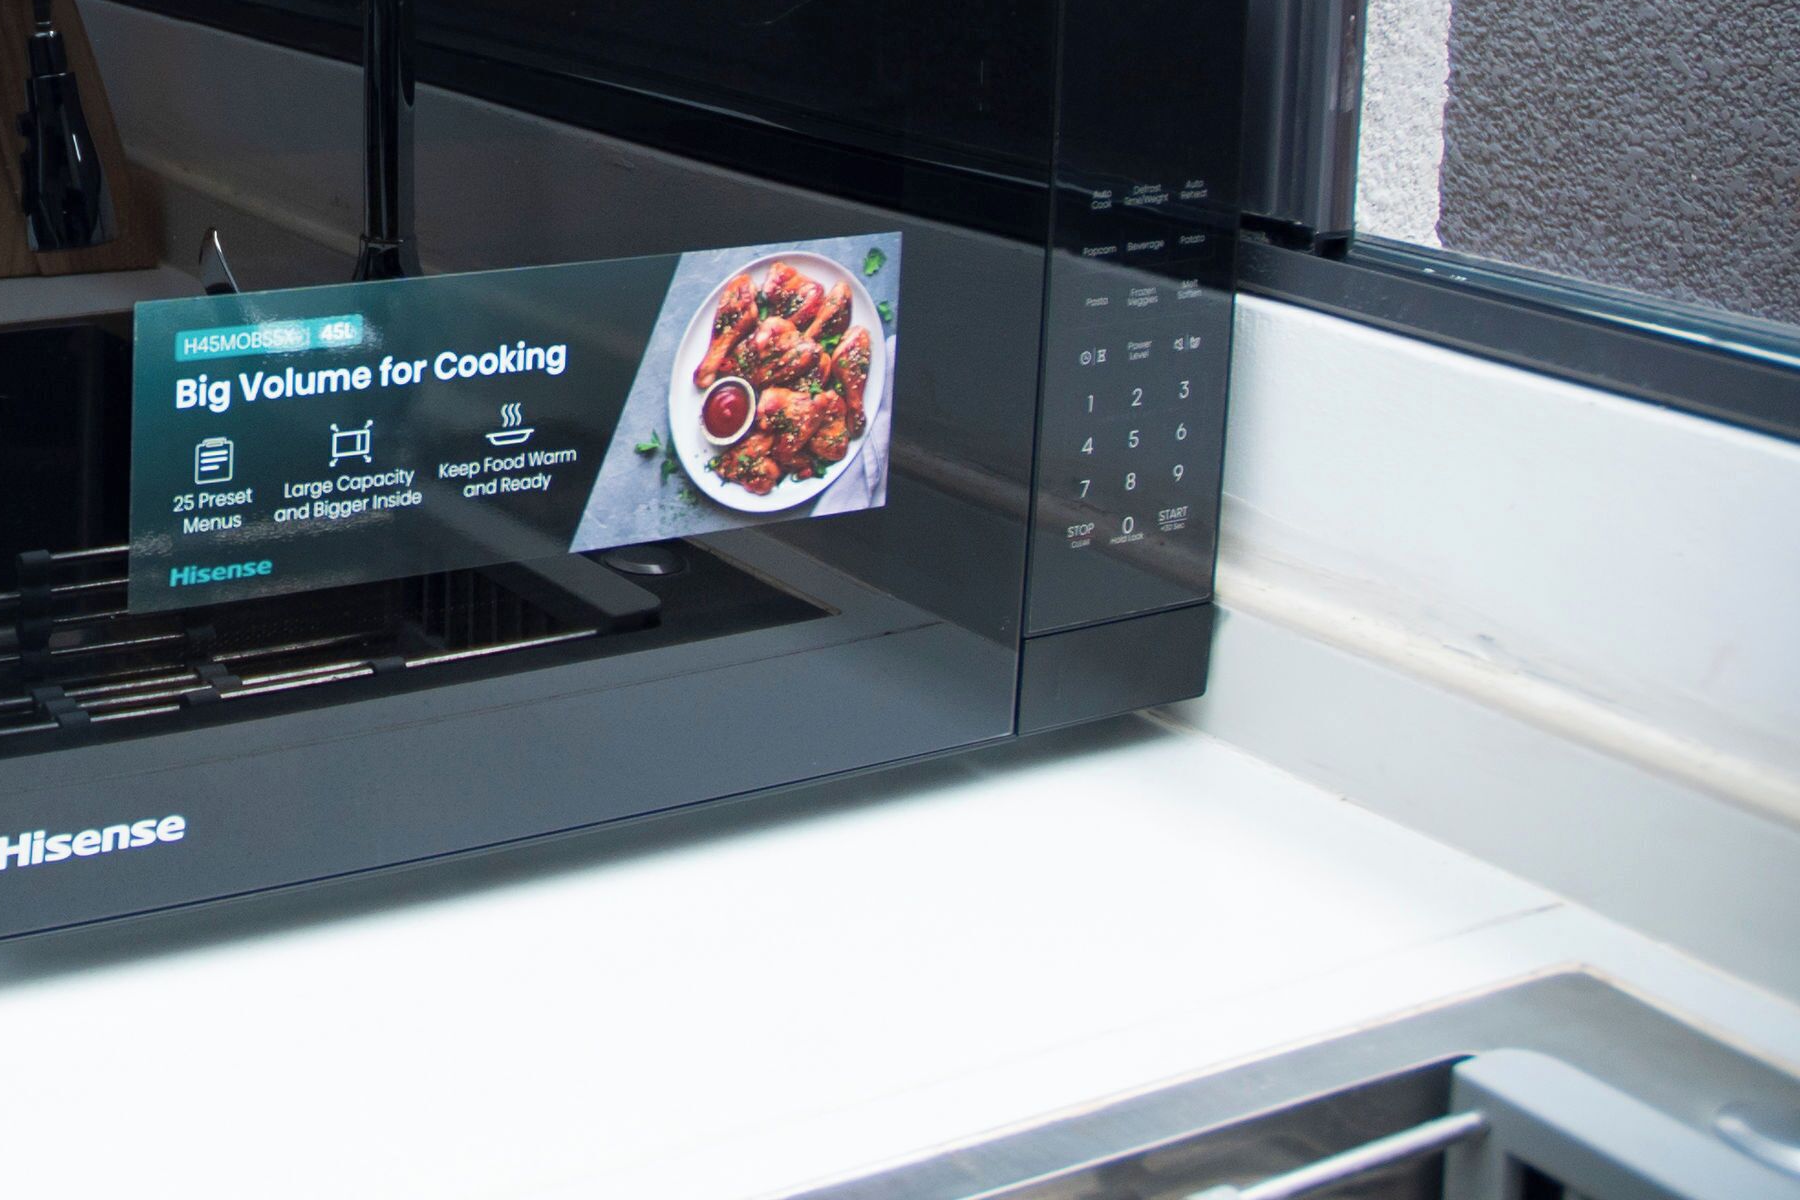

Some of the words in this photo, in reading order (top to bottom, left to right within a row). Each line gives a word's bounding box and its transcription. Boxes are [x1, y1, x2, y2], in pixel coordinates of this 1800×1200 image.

[1092, 200, 1112, 210] Cook
[1127, 240, 1165, 252] Beverage
[1180, 234, 1206, 245] Potato
[1083, 245, 1117, 257] Popcorn
[176, 374, 231, 413] Big
[238, 367, 372, 402] Volume
[379, 356, 427, 387] for
[434, 340, 567, 380] Cooking
[1131, 388, 1143, 406] 2
[1179, 380, 1189, 399] 3
[1087, 394, 1094, 413] 1
[1128, 429, 1139, 448] 5
[1176, 422, 1187, 440] 6
[1081, 437, 1093, 455] 4
[438, 461, 480, 479] Keep
[484, 452, 525, 473] Food
[528, 449, 577, 467] Warm
[1173, 464, 1184, 482] 9
[284, 479, 333, 499] Large
[337, 468, 415, 492] Capacity
[463, 478, 497, 498] and
[500, 472, 552, 492] Ready
[1080, 480, 1090, 499] 7
[1125, 472, 1136, 491] 8
[173, 494, 194, 513] 25
[199, 488, 253, 509] Preset
[274, 503, 310, 522] and
[314, 496, 369, 519] Bigger
[372, 490, 422, 511] Inside
[1159, 506, 1188, 521] START
[183, 513, 242, 534] Menus
[1067, 523, 1095, 538] STOP
[1122, 516, 1134, 534] 0
[169, 559, 273, 587] Hisense
